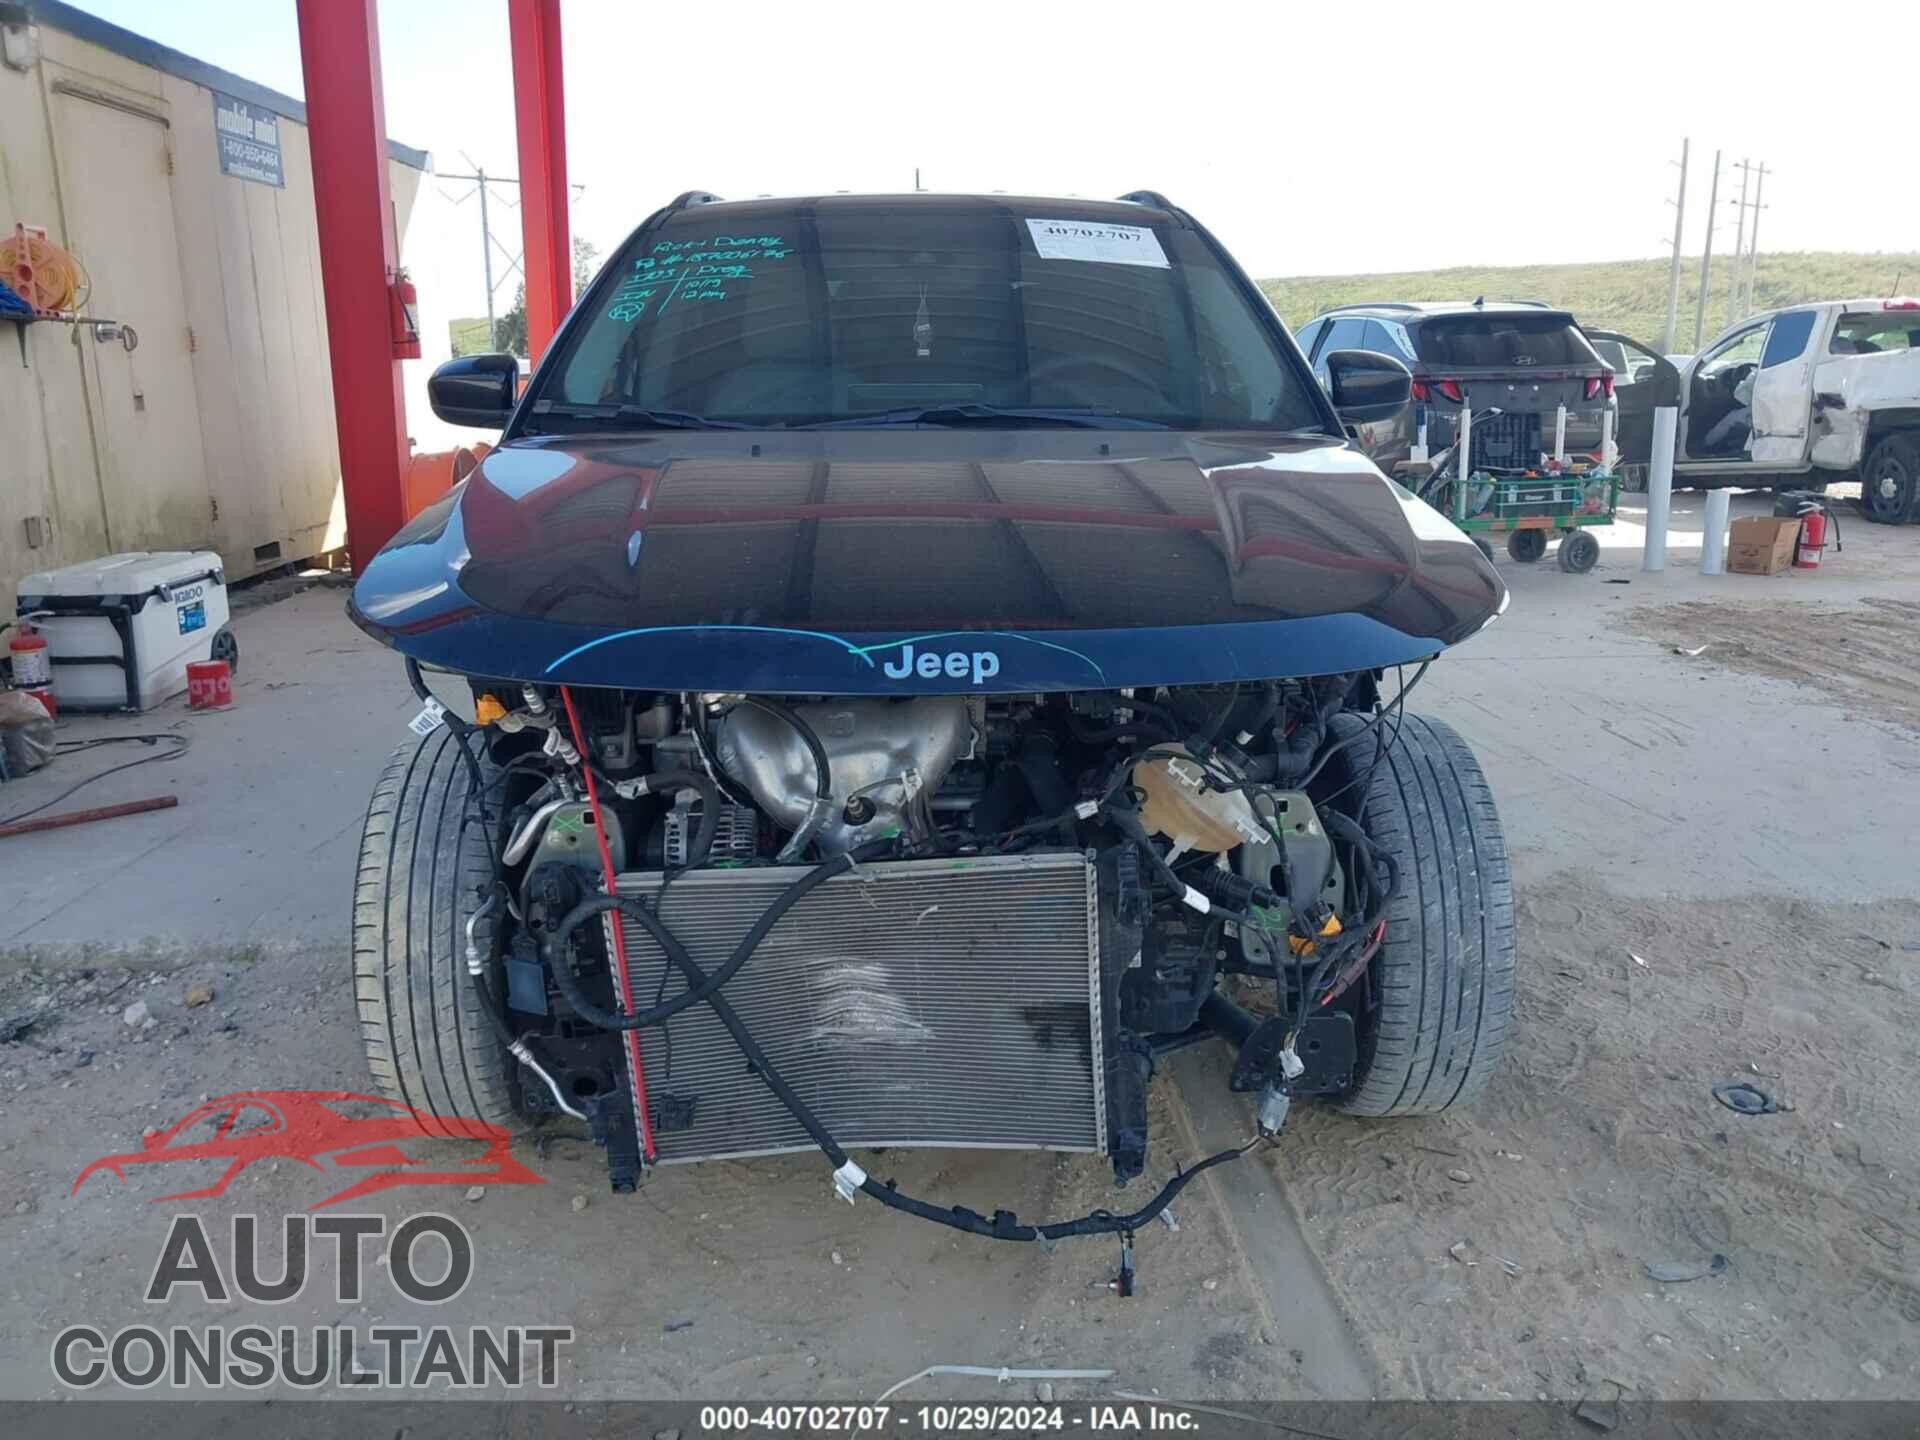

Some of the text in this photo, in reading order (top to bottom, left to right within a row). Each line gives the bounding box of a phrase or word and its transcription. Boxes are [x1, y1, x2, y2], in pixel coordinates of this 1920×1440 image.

[217, 102, 277, 145] mobile mini
[1044, 226, 1142, 242] 40702707
[884, 645, 1000, 684] Jeep
